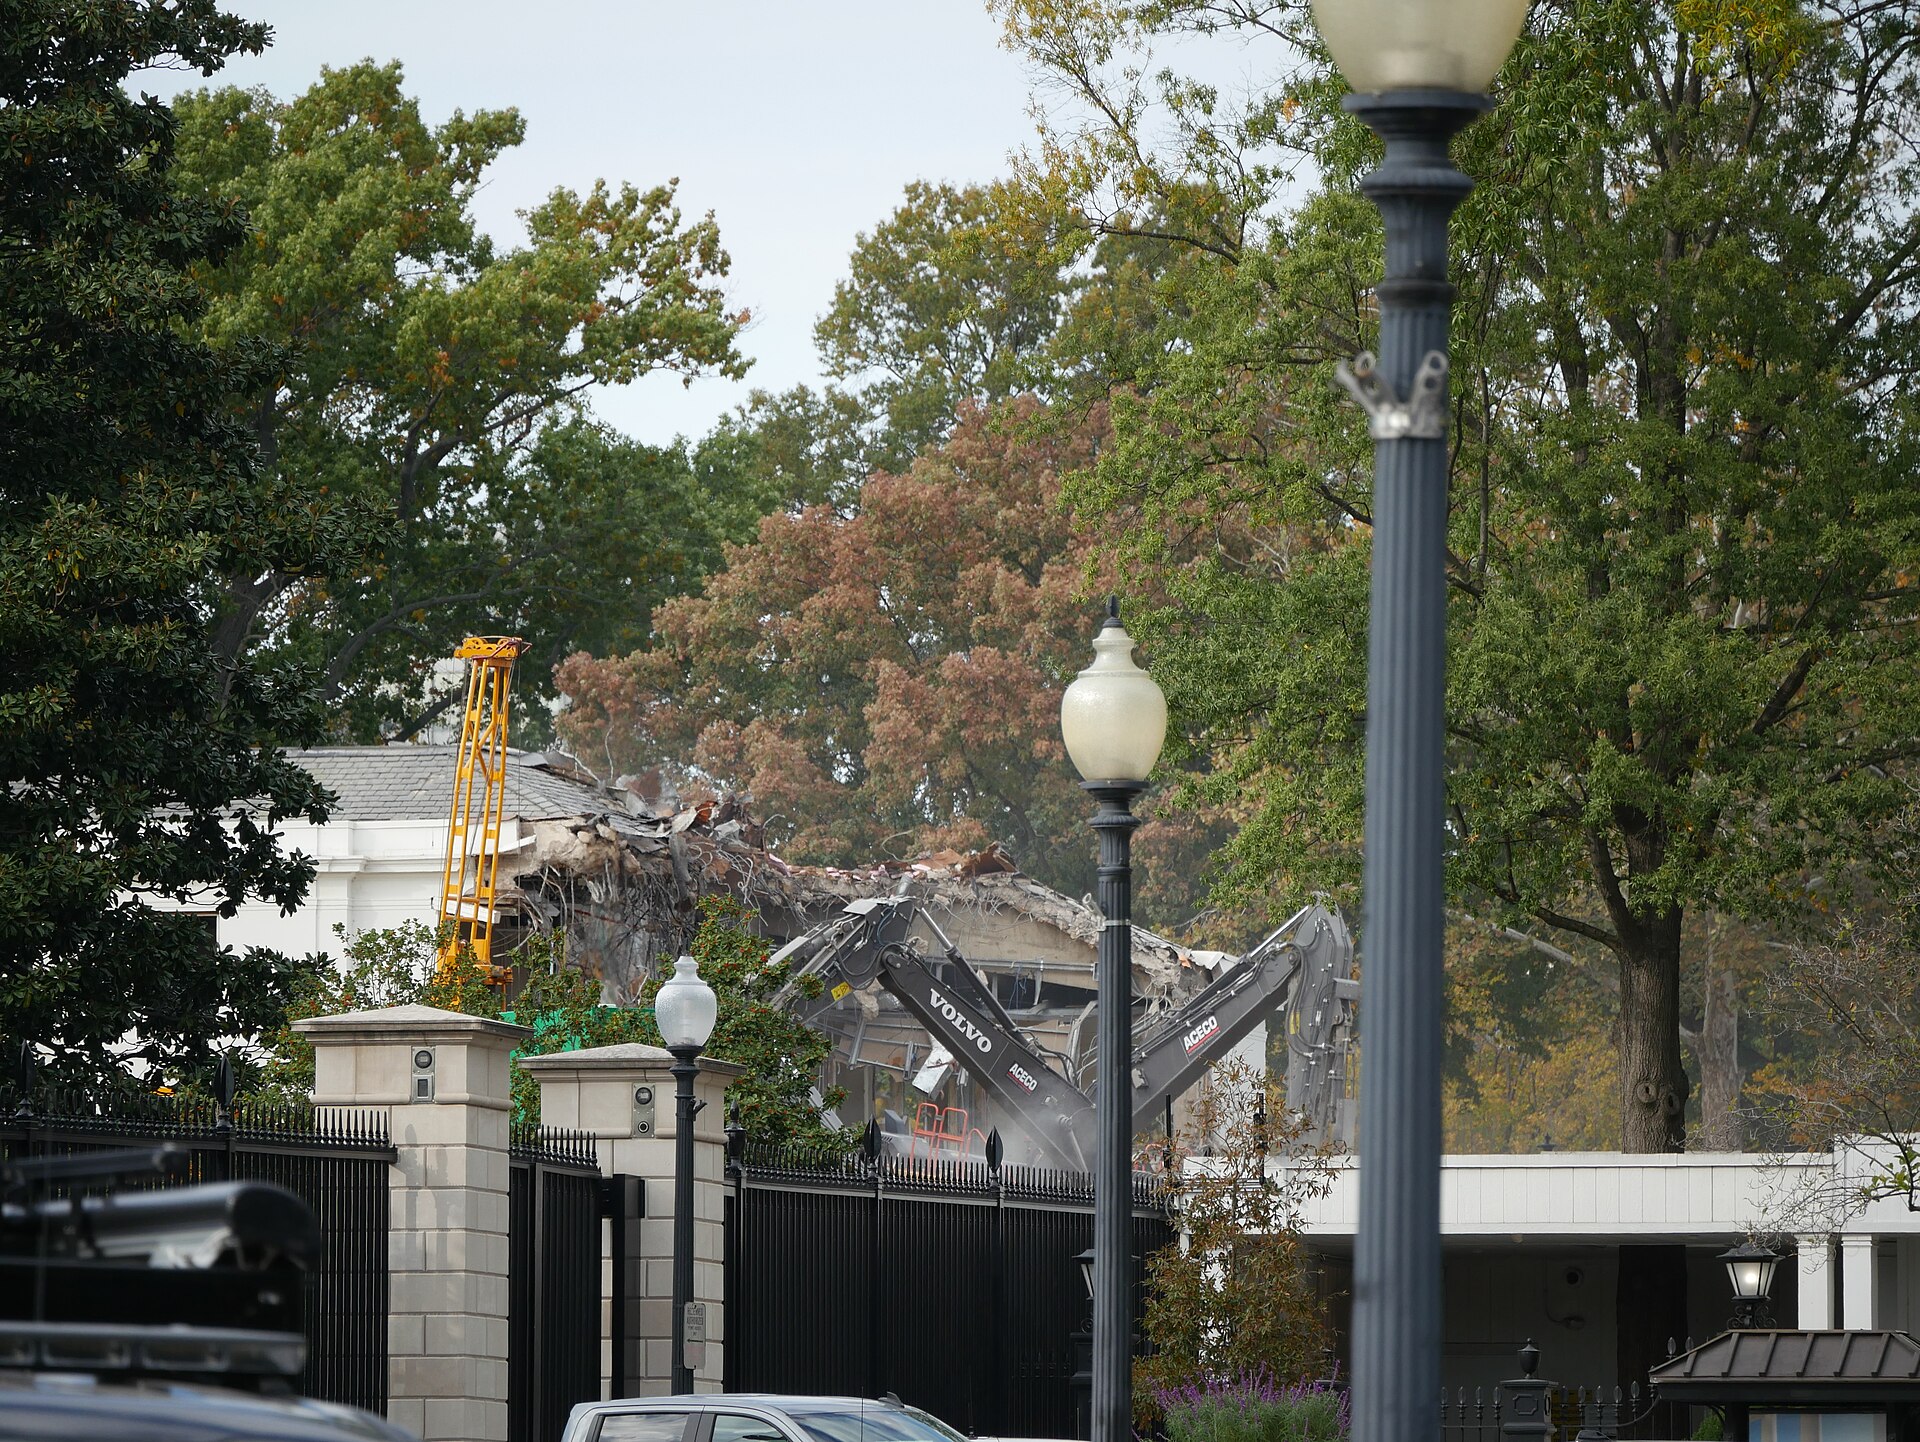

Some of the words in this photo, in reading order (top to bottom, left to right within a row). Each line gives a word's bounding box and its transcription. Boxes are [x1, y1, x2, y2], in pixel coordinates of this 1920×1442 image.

[930, 988, 992, 1053] VOLVO
[1183, 1015, 1218, 1051] ACECO
[1009, 1063, 1038, 1091] ACECO
